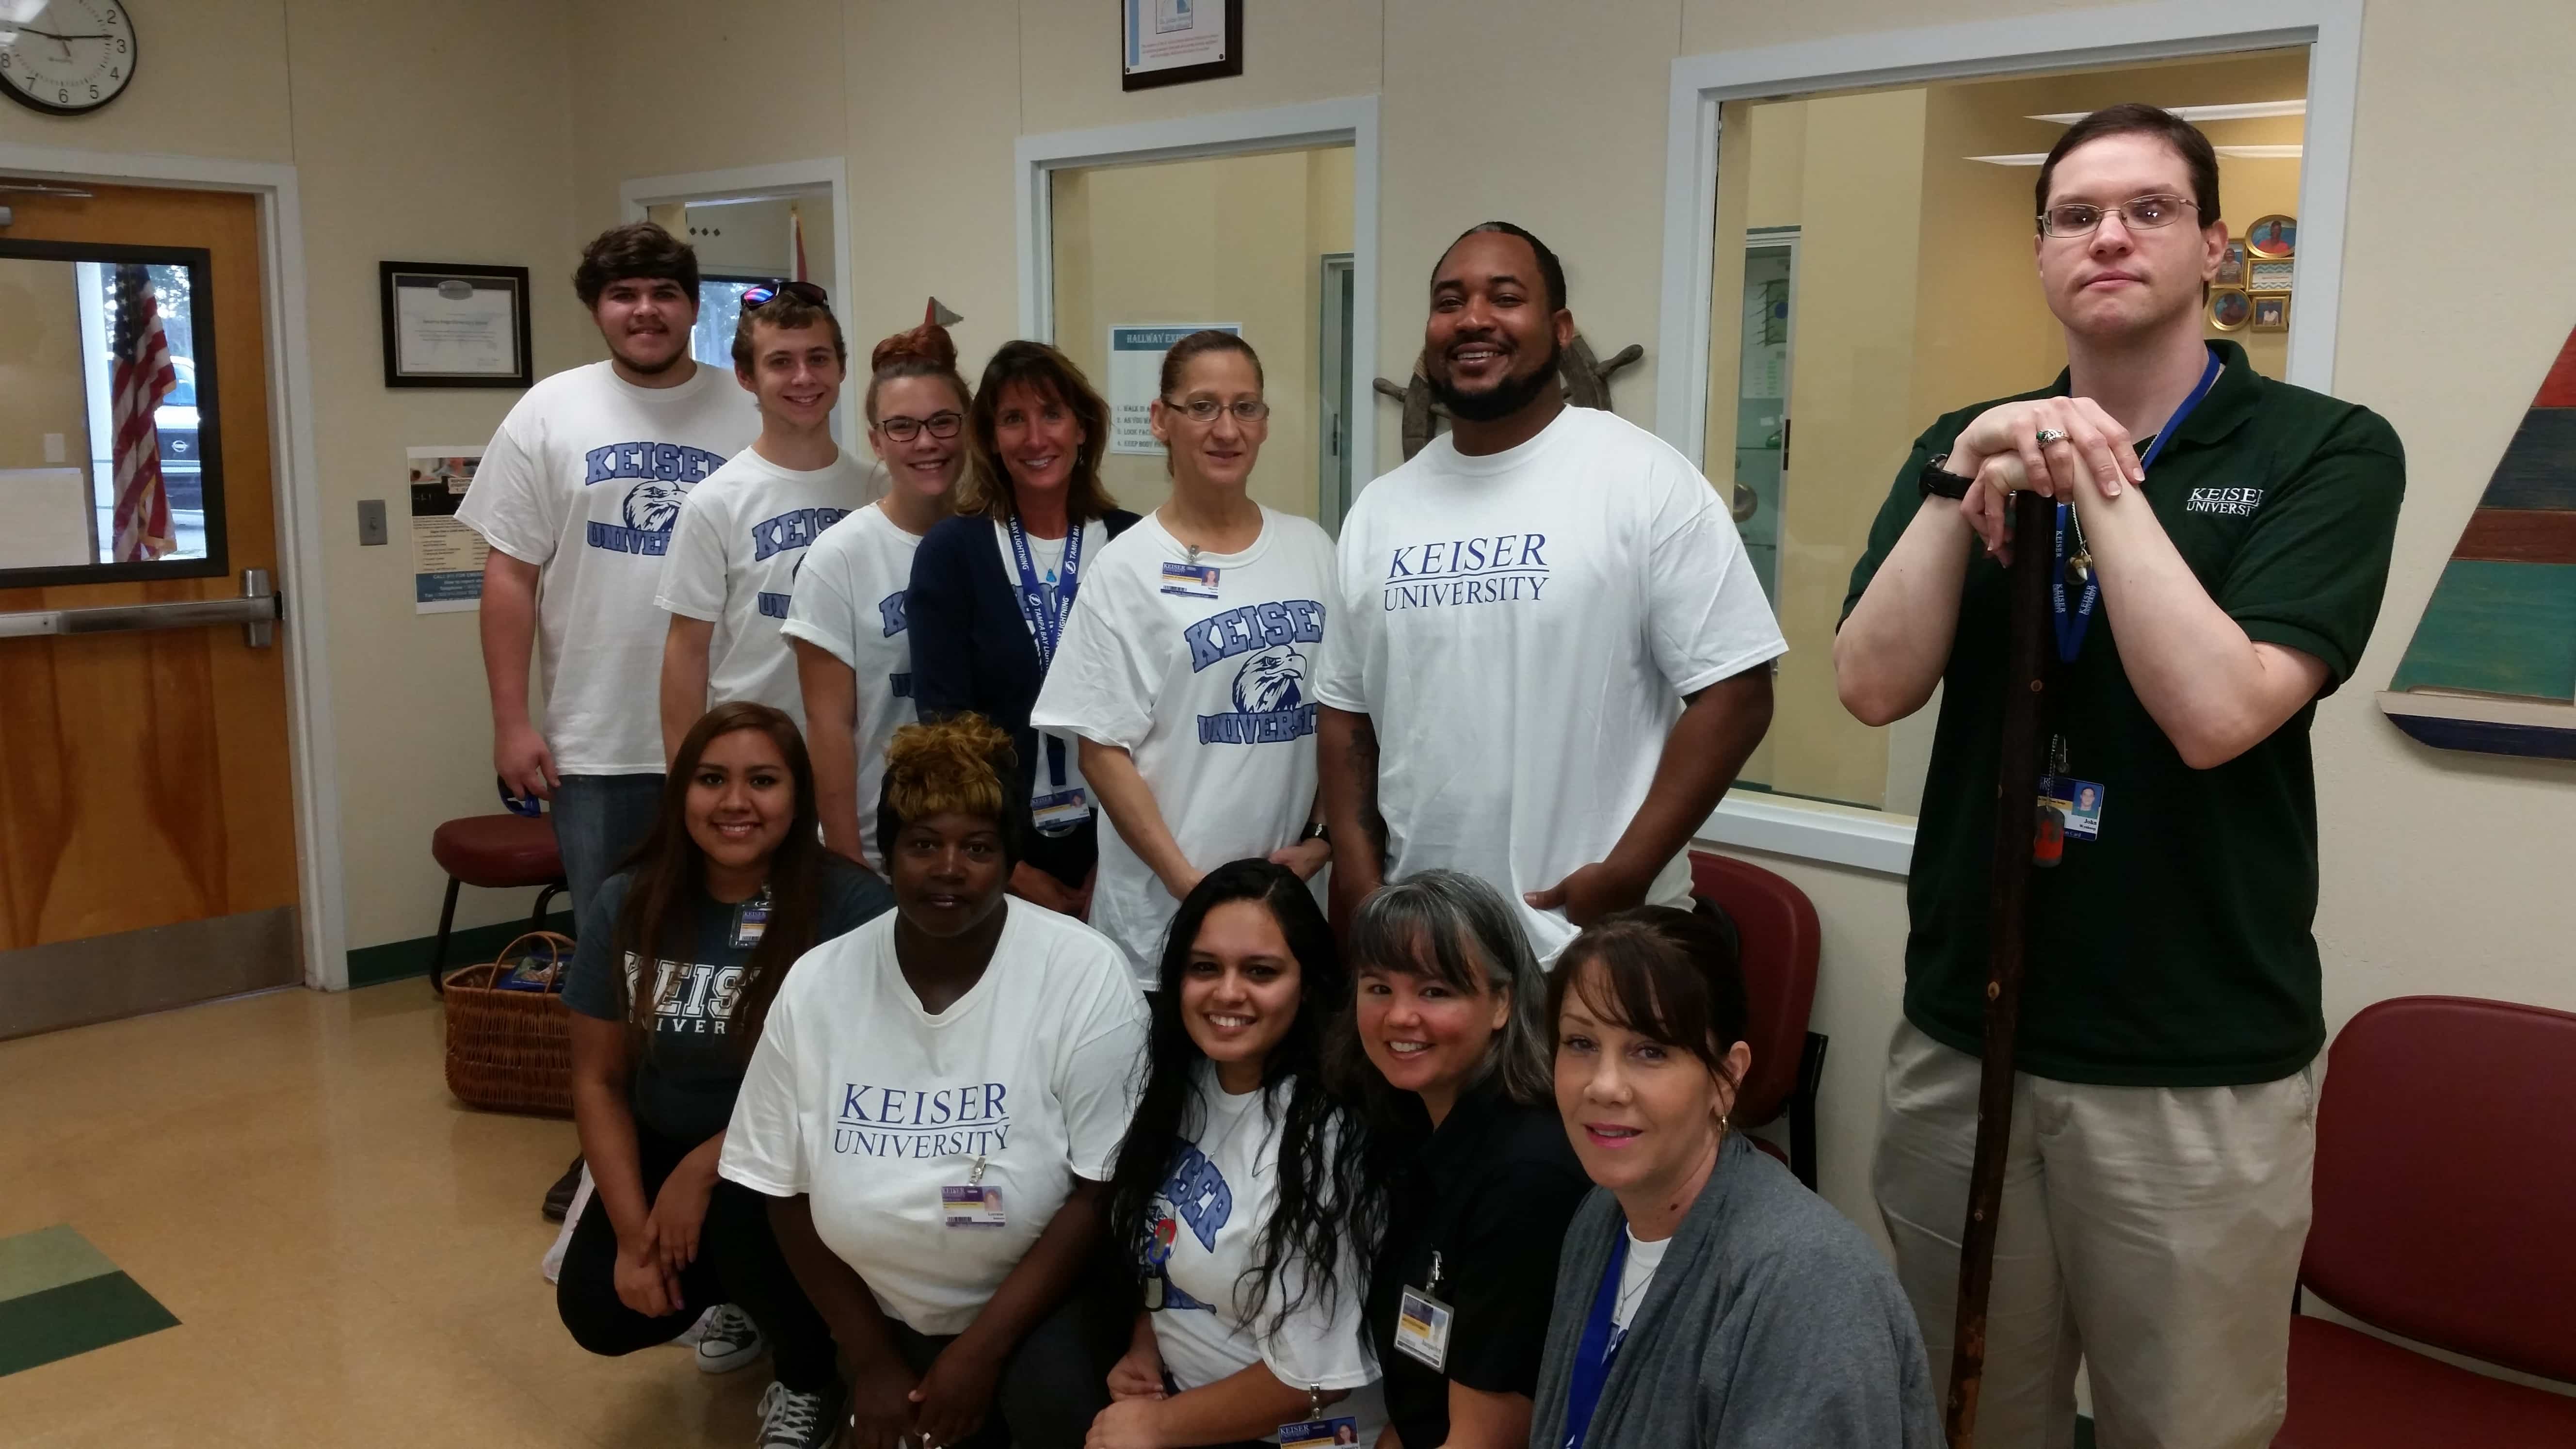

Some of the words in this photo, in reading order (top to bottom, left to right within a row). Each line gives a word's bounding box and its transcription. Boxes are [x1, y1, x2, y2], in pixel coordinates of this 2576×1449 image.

[107, 9, 117, 24] 2
[117, 39, 127, 54] 3
[0, 53, 11, 68] 8
[110, 66, 120, 81] 4
[26, 77, 35, 91] 7
[58, 89, 68, 103] 6
[89, 85, 99, 99] 5
[1127, 333, 1164, 343] HALLWAY
[1010, 521, 1019, 534] BAY
[1013, 535, 1029, 570] LIGHTNING
[1070, 537, 1079, 559] TAMPA
[1387, 533, 1548, 580] KEISER
[1163, 563, 1186, 571] KEISER
[1384, 577, 1549, 612] UNIVERSITY
[2057, 583, 2066, 613] KEISER
[2078, 585, 2093, 614] KEISER
[1034, 608, 1046, 631] TAMPA
[1040, 631, 1049, 645] BAY
[839, 1082, 1007, 1126] KEISER
[834, 1124, 1012, 1159] UNIVERSITY
[1280, 1424, 1309, 1434] KEISER
